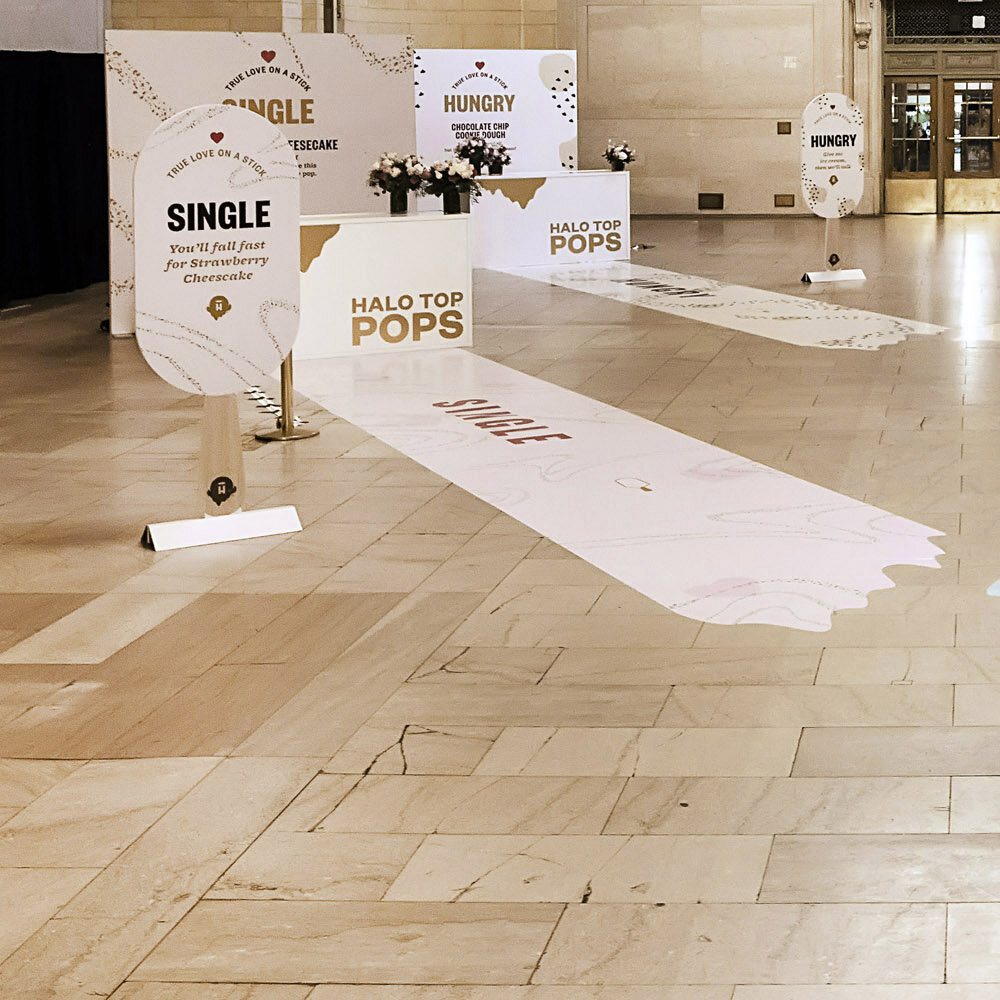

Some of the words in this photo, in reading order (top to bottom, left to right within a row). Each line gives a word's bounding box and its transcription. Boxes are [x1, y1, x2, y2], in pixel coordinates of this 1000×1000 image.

[225, 73, 245, 91] TRUE
[245, 66, 266, 77] LOVE
[290, 73, 311, 92] STICK
[452, 77, 464, 89] TRUE
[465, 72, 478, 80] LOVE
[494, 76, 508, 90] STICK
[222, 99, 314, 124] NGLE
[444, 94, 515, 112] HUNGRY
[451, 123, 491, 131] CHOCOLATE
[493, 122, 509, 130] CHIP
[811, 134, 857, 148] HUNGRY
[166, 158, 189, 179] TRUE
[190, 149, 215, 162] LOVE
[217, 149, 231, 157] ON
[233, 152, 240, 160] A
[242, 155, 267, 177] STICK
[167, 200, 270, 232] SINGLE
[550, 221, 589, 234] HALO
[593, 220, 621, 231] TOP
[169, 242, 209, 254] You'll
[210, 240, 236, 255] fall
[237, 240, 266, 253] fast
[550, 232, 621, 255] POPS
[163, 259, 187, 273] for
[190, 256, 269, 269] Strawberry
[352, 294, 413, 313] HALO
[419, 291, 464, 309] TOP
[352, 309, 464, 346] POPS
[432, 398, 573, 445] SINGLE
